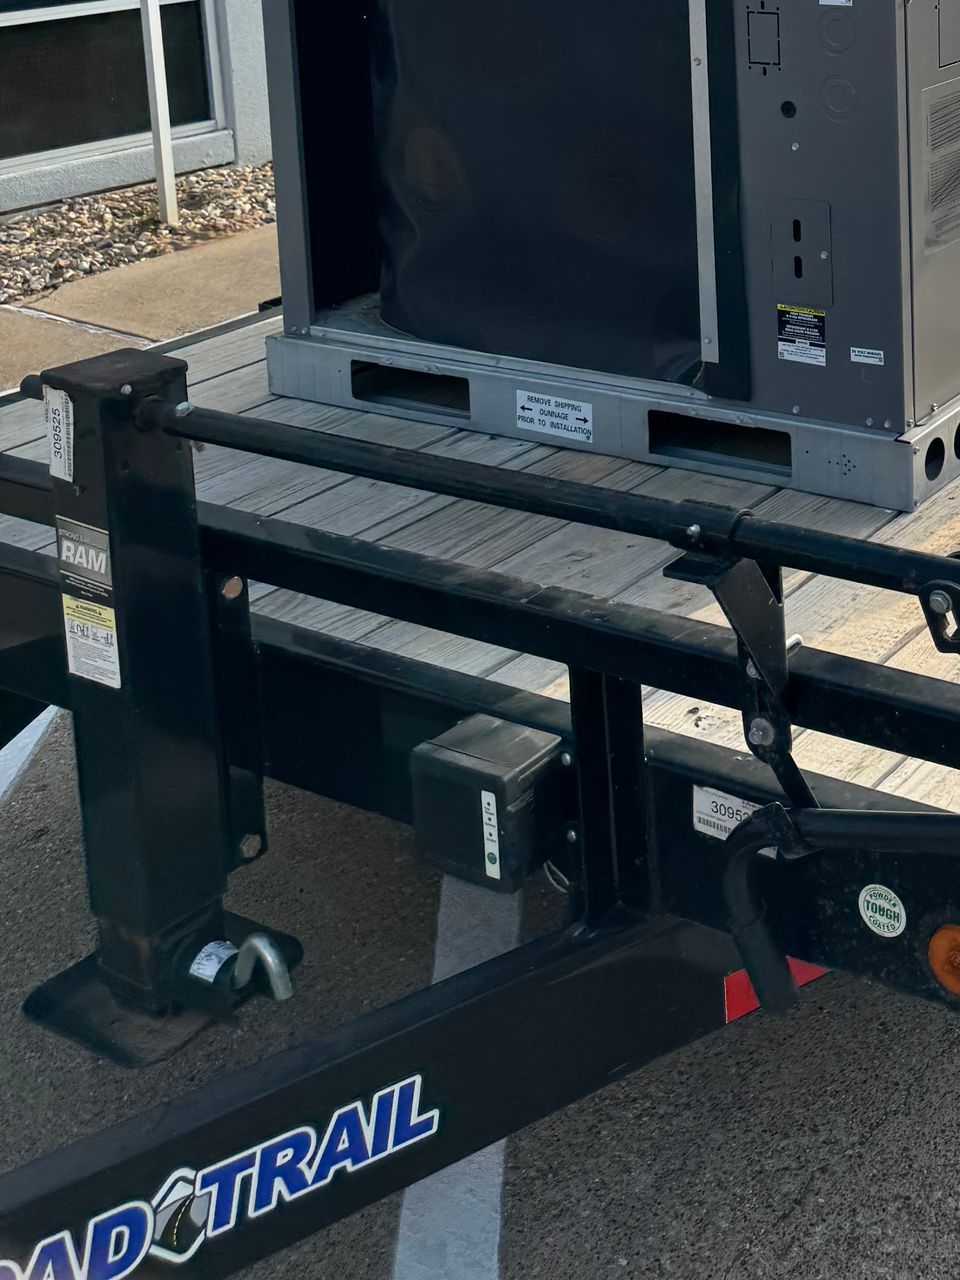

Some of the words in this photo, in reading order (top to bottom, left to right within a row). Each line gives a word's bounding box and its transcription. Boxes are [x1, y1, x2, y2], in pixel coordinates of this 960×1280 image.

[527, 395, 551, 407] REMOVE
[554, 400, 582, 412] SHIPPING
[539, 408, 569, 421] DUNNAGE
[51, 407, 63, 459] 309525
[517, 415, 535, 424] PRIOR
[538, 418, 546, 427] TO
[550, 422, 592, 436] INSTALLATION
[61, 540, 107, 574] RAM
[869, 891, 897, 908] POWDER
[865, 899, 900, 923] TOUGH
[868, 914, 896, 932] COATED
[0, 1199, 155, 1280] AD
[197, 1074, 440, 1238] TRAIL
